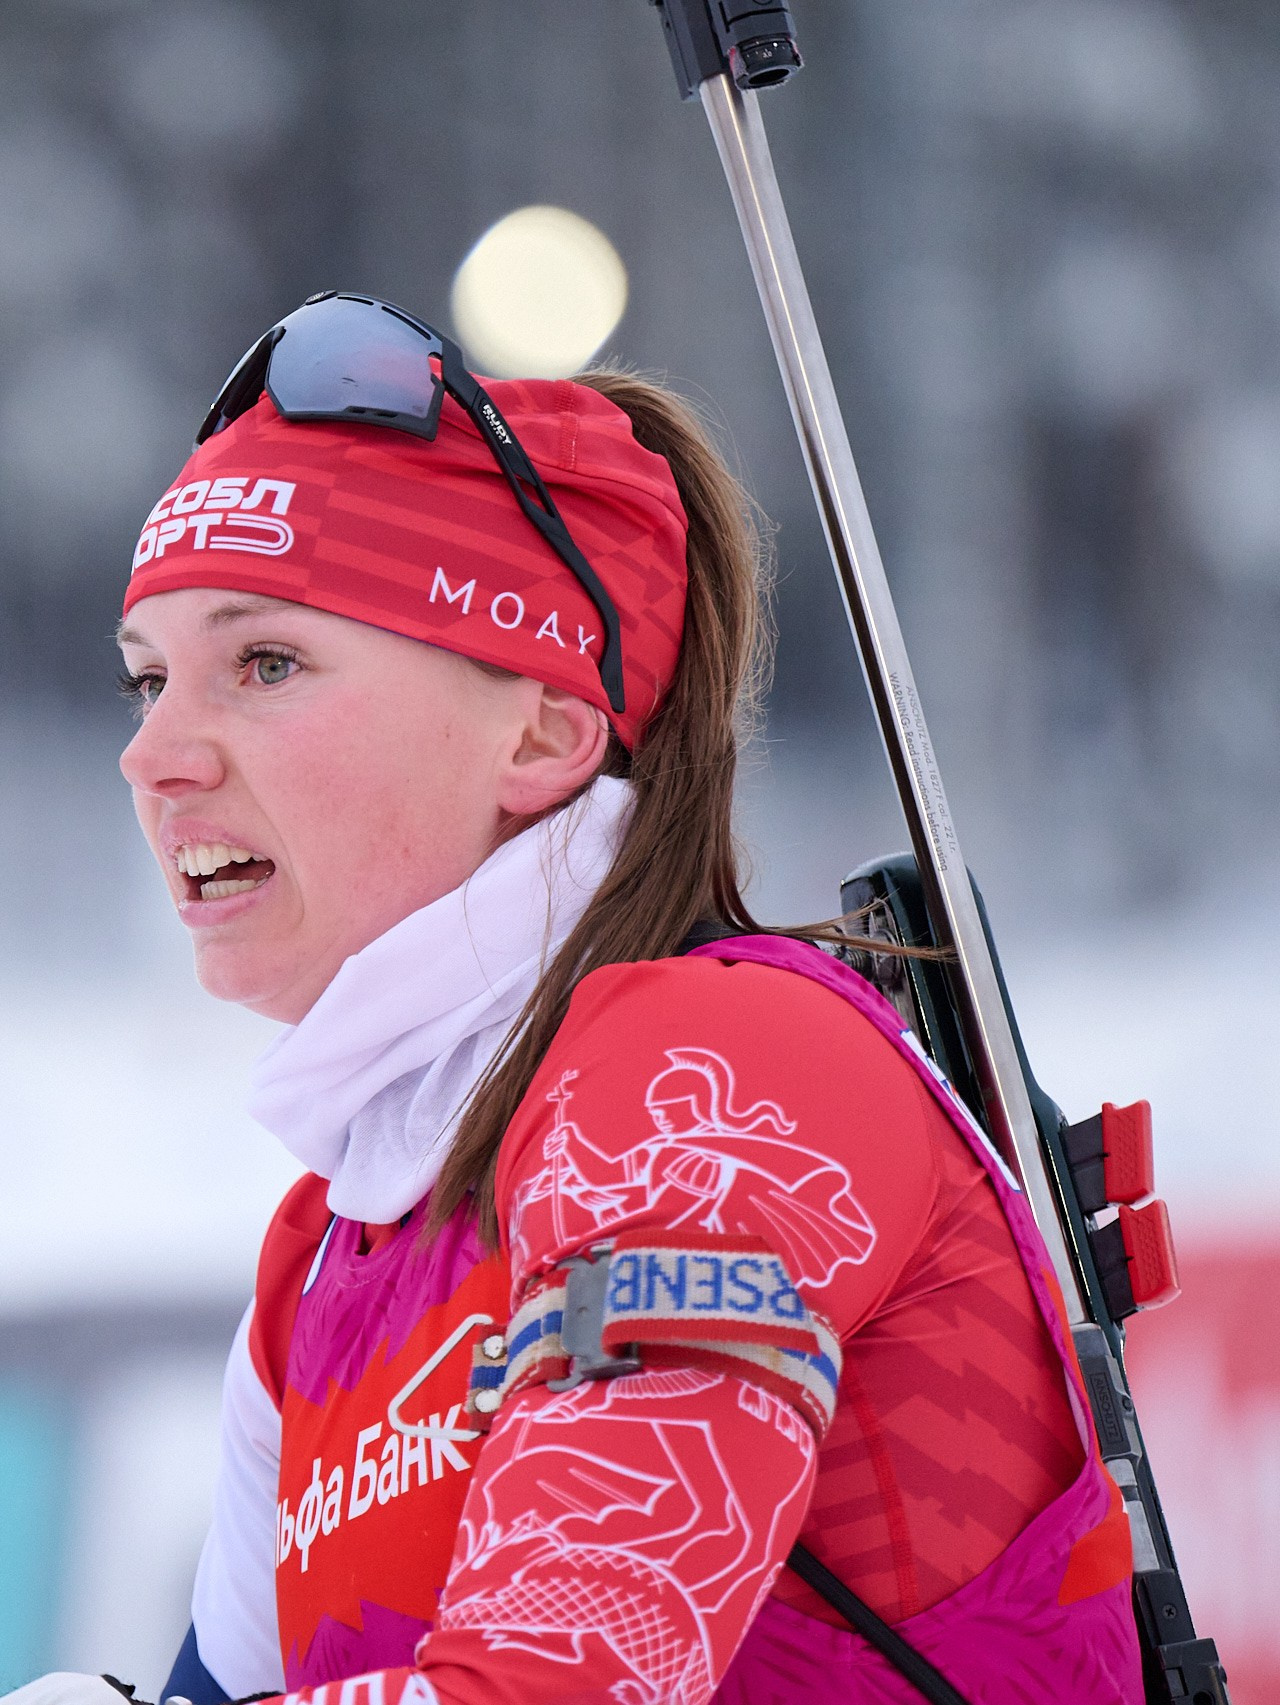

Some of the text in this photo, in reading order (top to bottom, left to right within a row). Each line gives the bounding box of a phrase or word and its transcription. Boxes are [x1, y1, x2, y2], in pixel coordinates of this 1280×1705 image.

[483, 404, 512, 444] RUDY
[141, 477, 297, 533] СОБЛ
[131, 512, 224, 576] ОРТ
[428, 566, 596, 655] MOAY
[888, 671, 949, 872] WARNING: Read instructions before using
[347, 1403, 472, 1521] Банк
